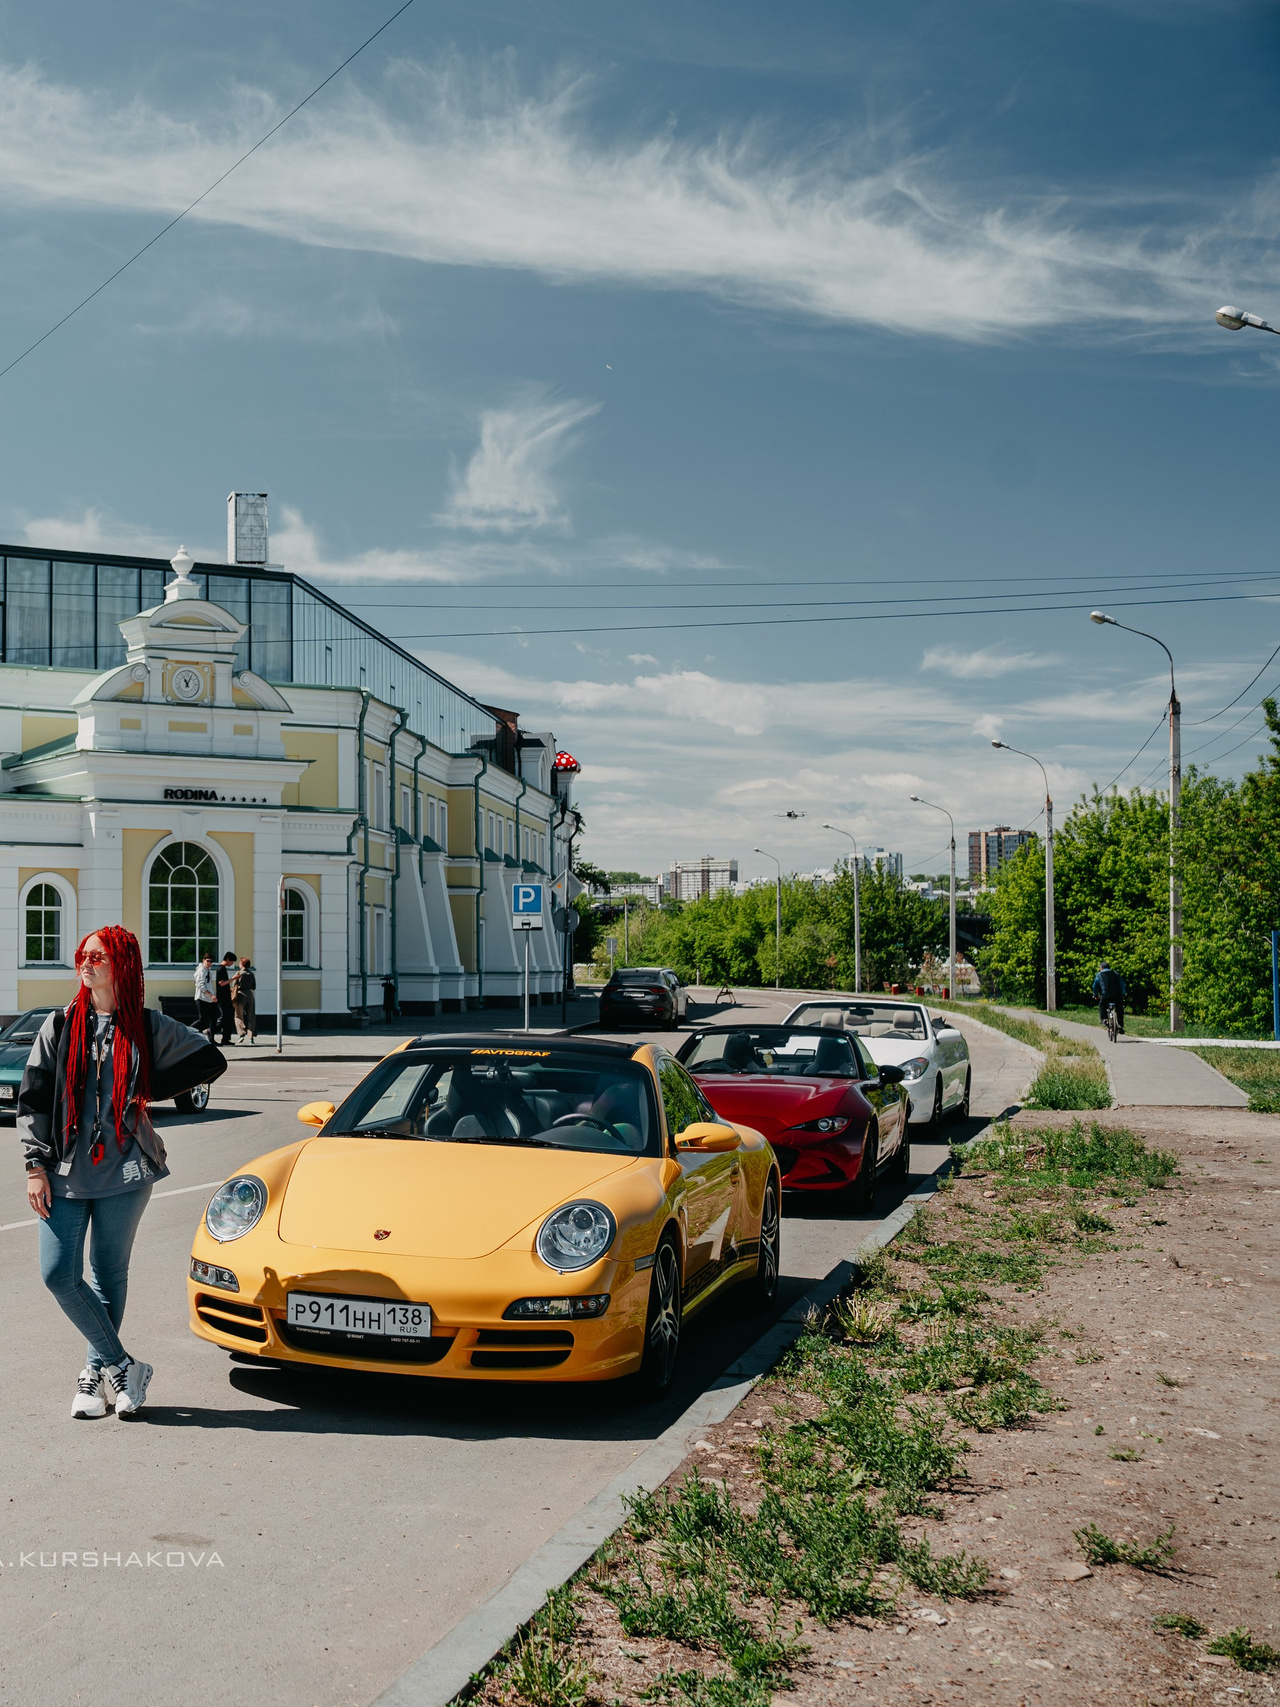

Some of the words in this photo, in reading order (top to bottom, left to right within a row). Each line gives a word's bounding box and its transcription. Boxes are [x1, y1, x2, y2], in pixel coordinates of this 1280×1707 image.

[163, 788, 219, 801] RODINA
[518, 887, 536, 911] P
[294, 1301, 381, 1330] Р911НН
[386, 1307, 423, 1326] 138
[399, 1326, 418, 1334] RUS
